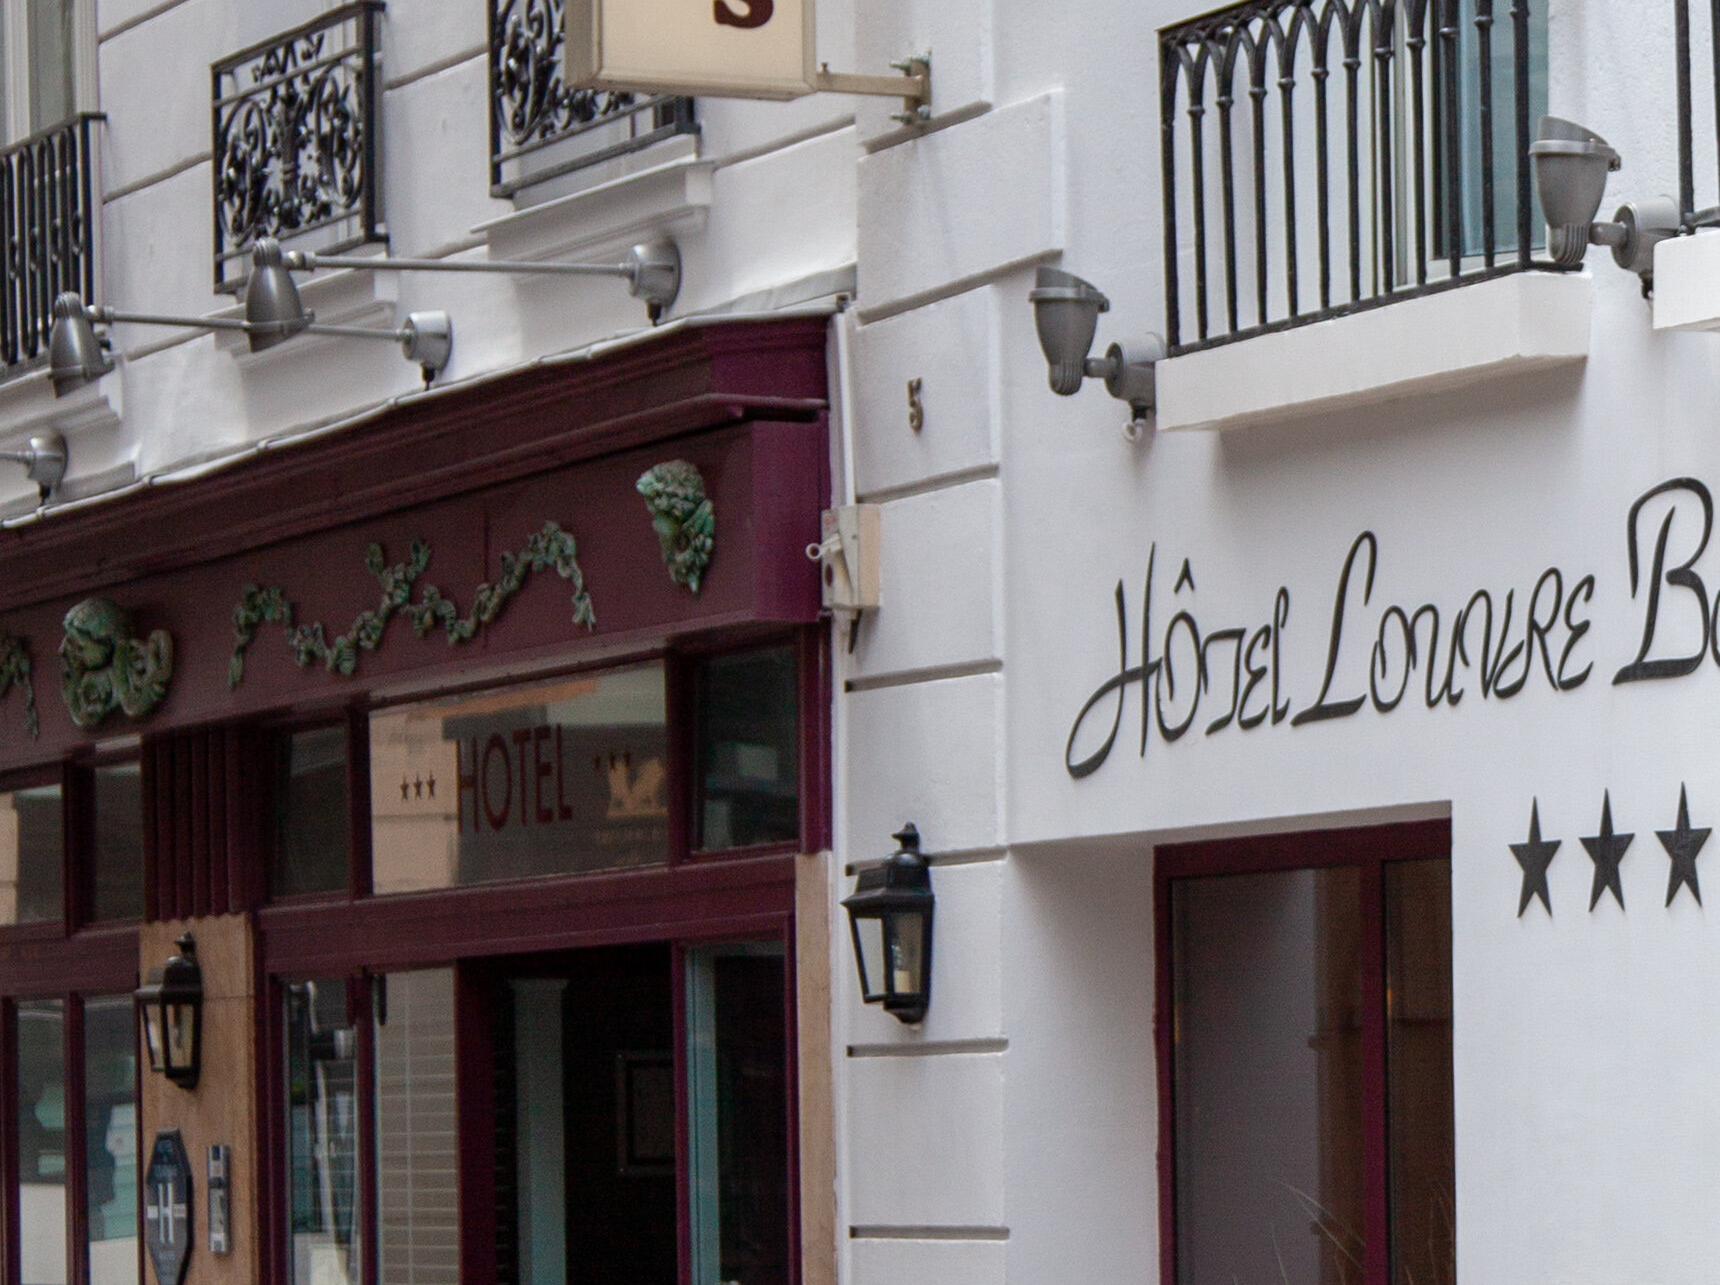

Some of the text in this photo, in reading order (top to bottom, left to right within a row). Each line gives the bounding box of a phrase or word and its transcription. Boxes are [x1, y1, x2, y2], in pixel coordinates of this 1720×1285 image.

[907, 377, 923, 432] 5
[1290, 530, 1595, 728] LOUVRE
[456, 723, 573, 833] HOTEL
